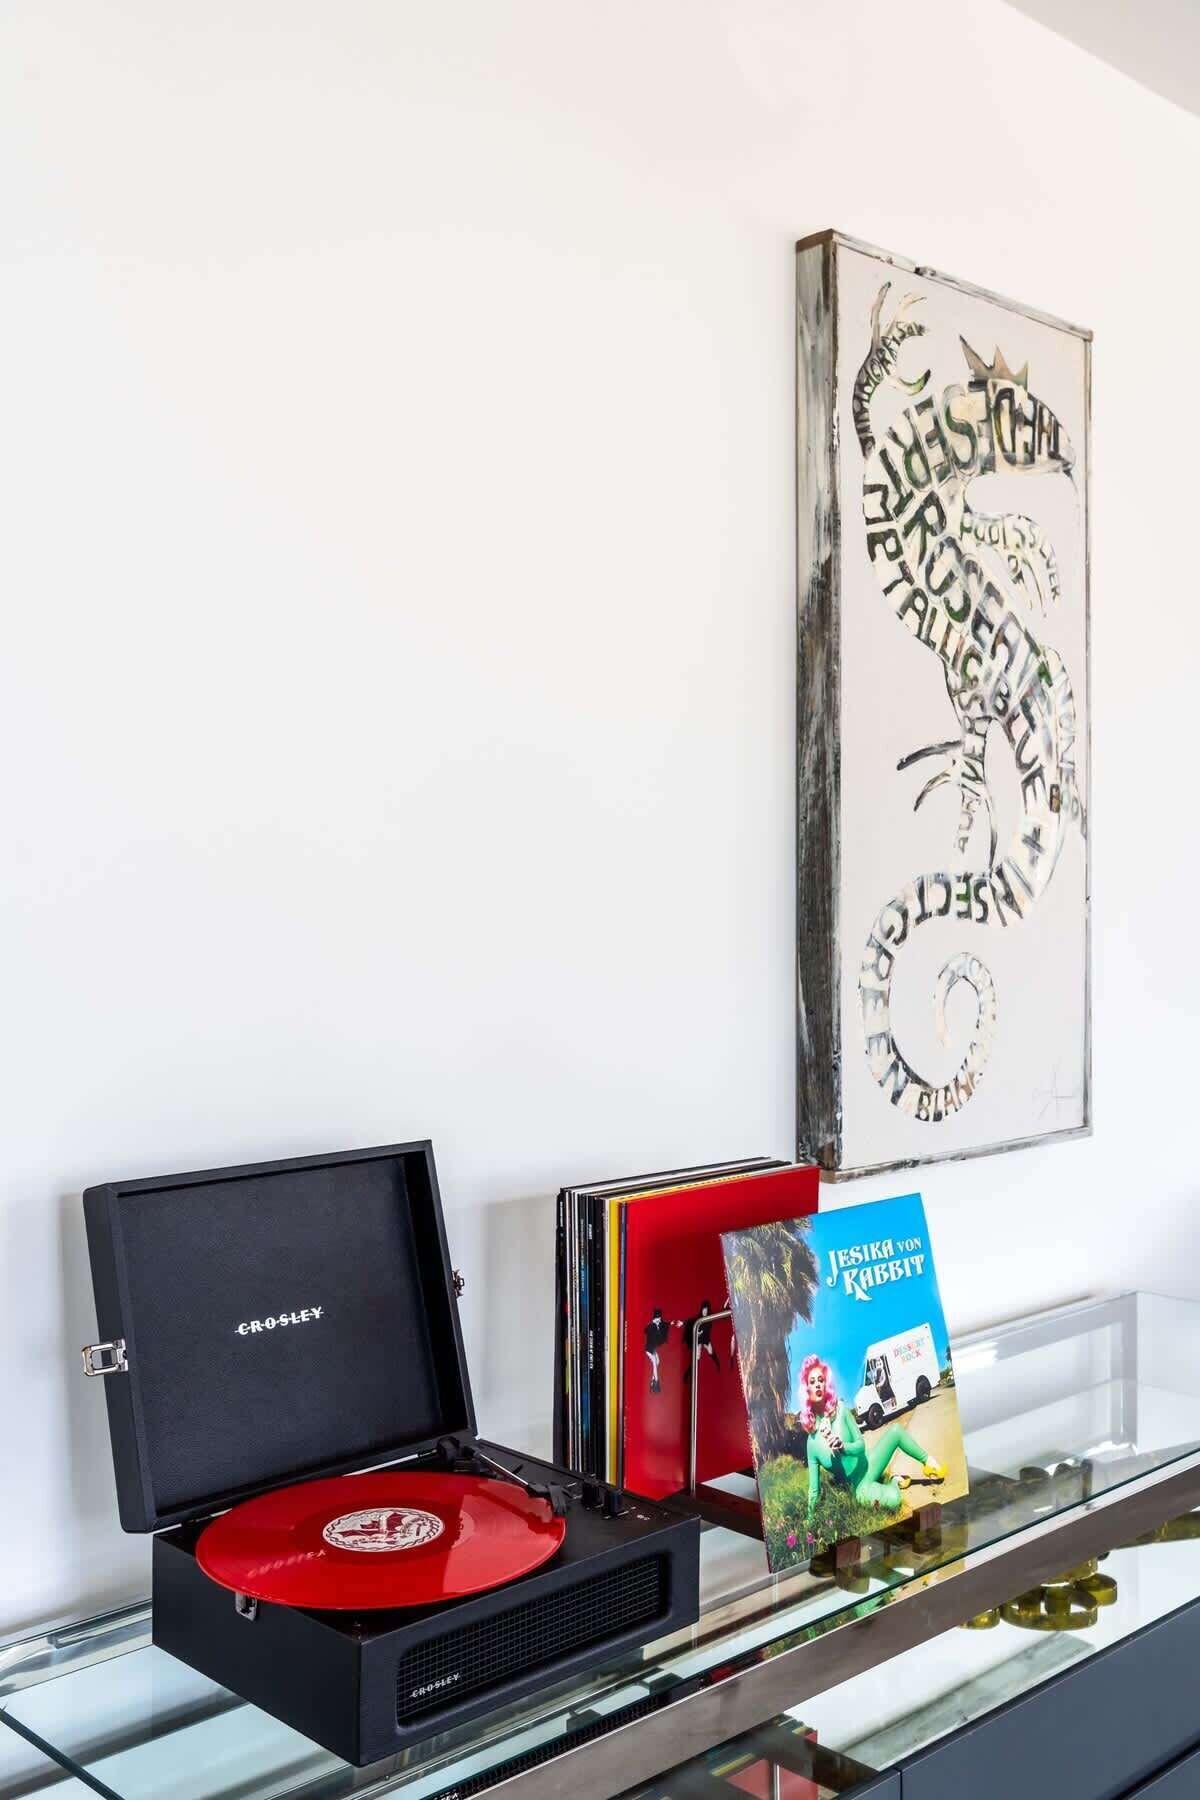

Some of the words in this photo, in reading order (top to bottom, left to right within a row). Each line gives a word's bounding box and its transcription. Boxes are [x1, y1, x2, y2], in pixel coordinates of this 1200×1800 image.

[878, 380, 1016, 520] DESERT
[913, 858, 1036, 927] INSECT
[826, 1239, 895, 1287] JESIKA
[896, 1237, 922, 1253] VON
[842, 1254, 925, 1301] RABBIT
[235, 1306, 324, 1335] CROSLEY
[409, 1672, 460, 1698] CROSLEY
